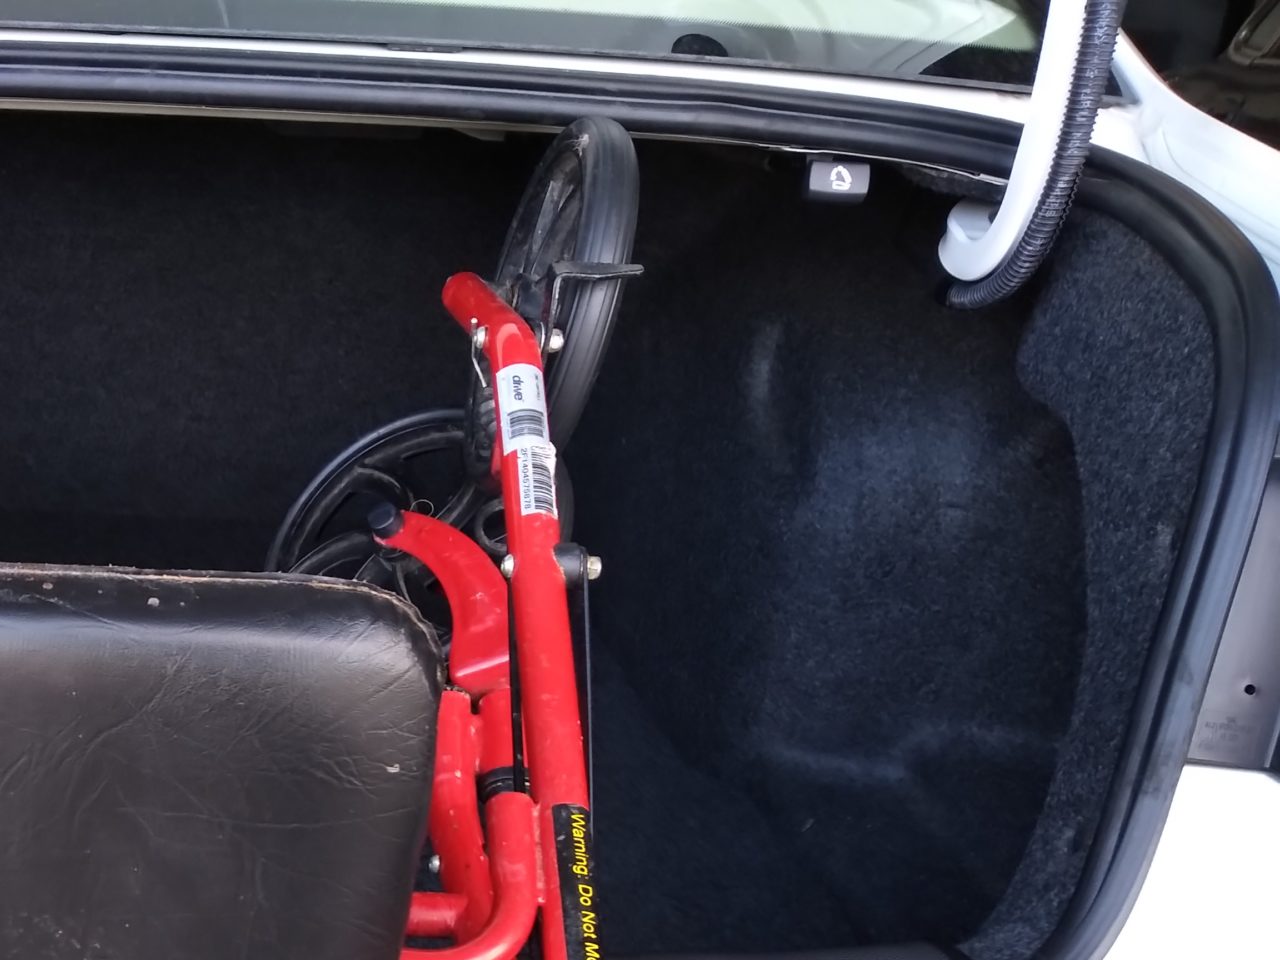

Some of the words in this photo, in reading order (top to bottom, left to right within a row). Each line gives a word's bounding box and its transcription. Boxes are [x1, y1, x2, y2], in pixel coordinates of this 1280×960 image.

[512, 374, 524, 402] drive
[570, 812, 589, 880] Warning:
[577, 883, 594, 907] Do
[580, 910, 598, 940] Not
